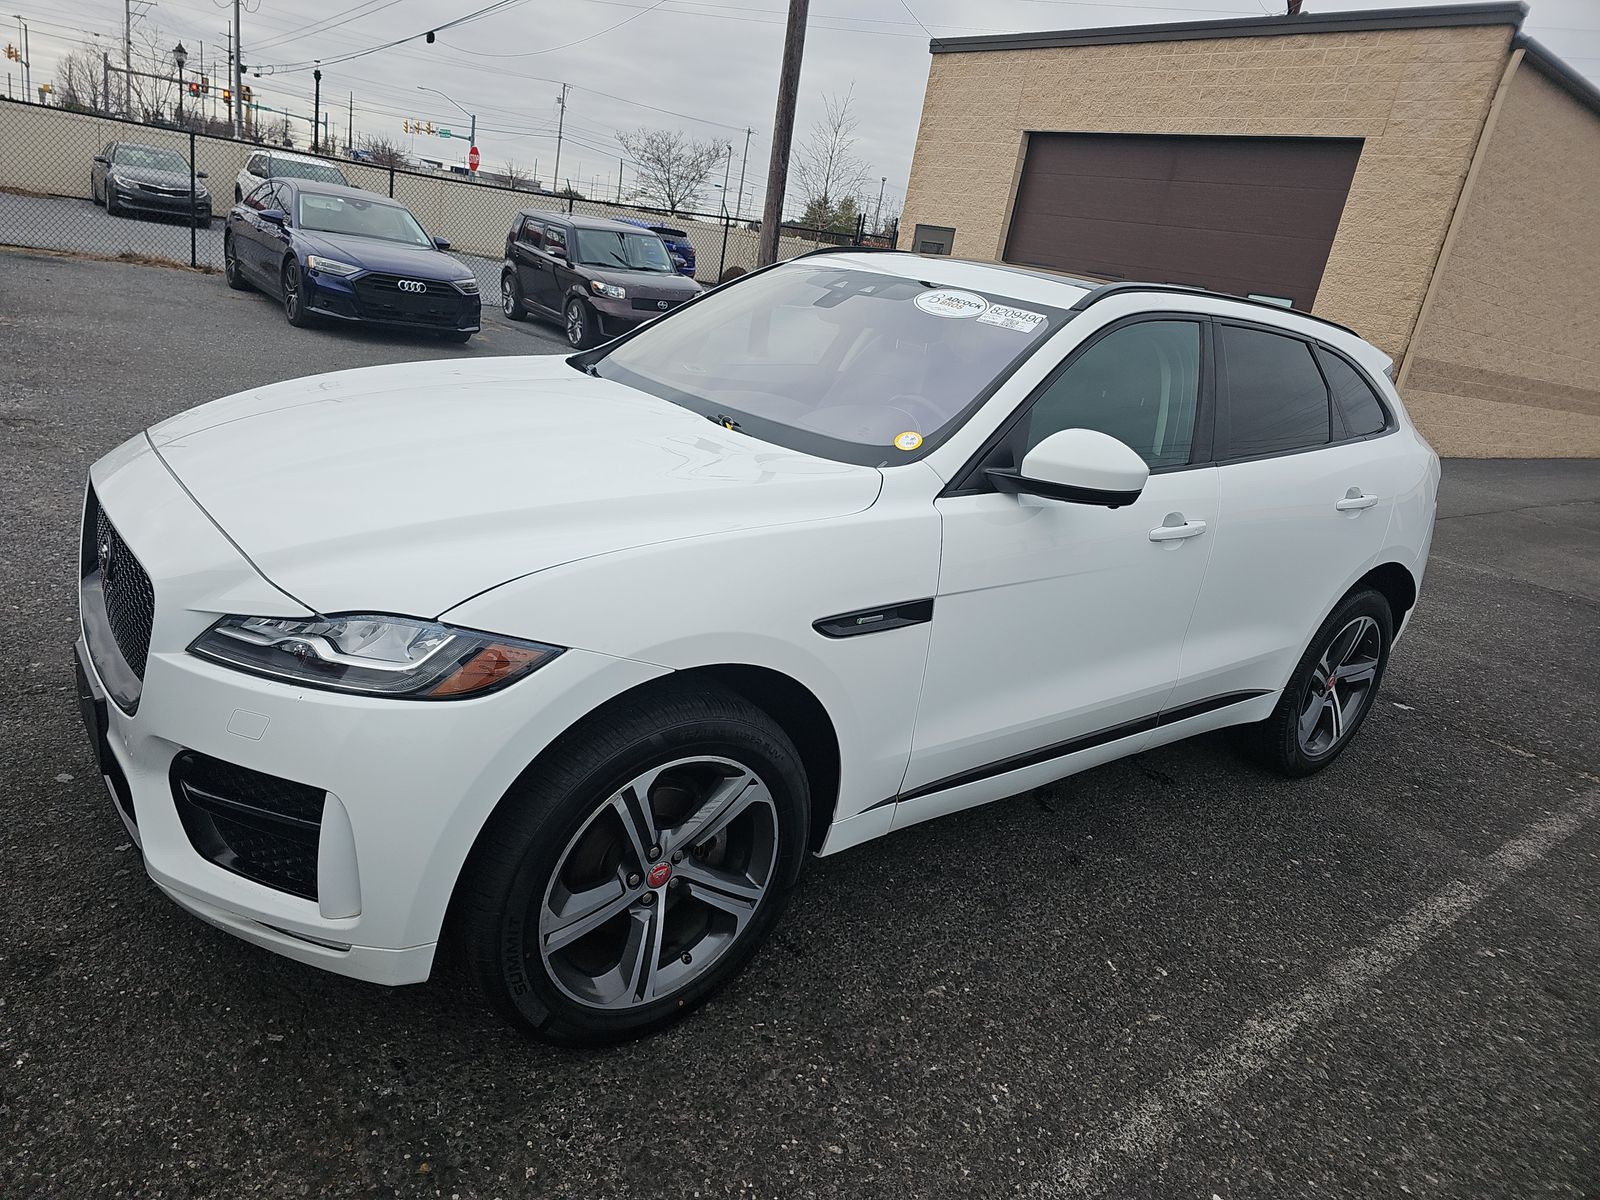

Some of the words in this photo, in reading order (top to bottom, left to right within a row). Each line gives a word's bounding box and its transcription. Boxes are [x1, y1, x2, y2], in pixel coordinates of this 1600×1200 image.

[469, 154, 479, 164] STOP
[939, 300, 965, 310] BROS
[945, 296, 983, 309] ADCOCK
[990, 306, 1043, 324] 8209490
[507, 916, 529, 996] SUMMIT
